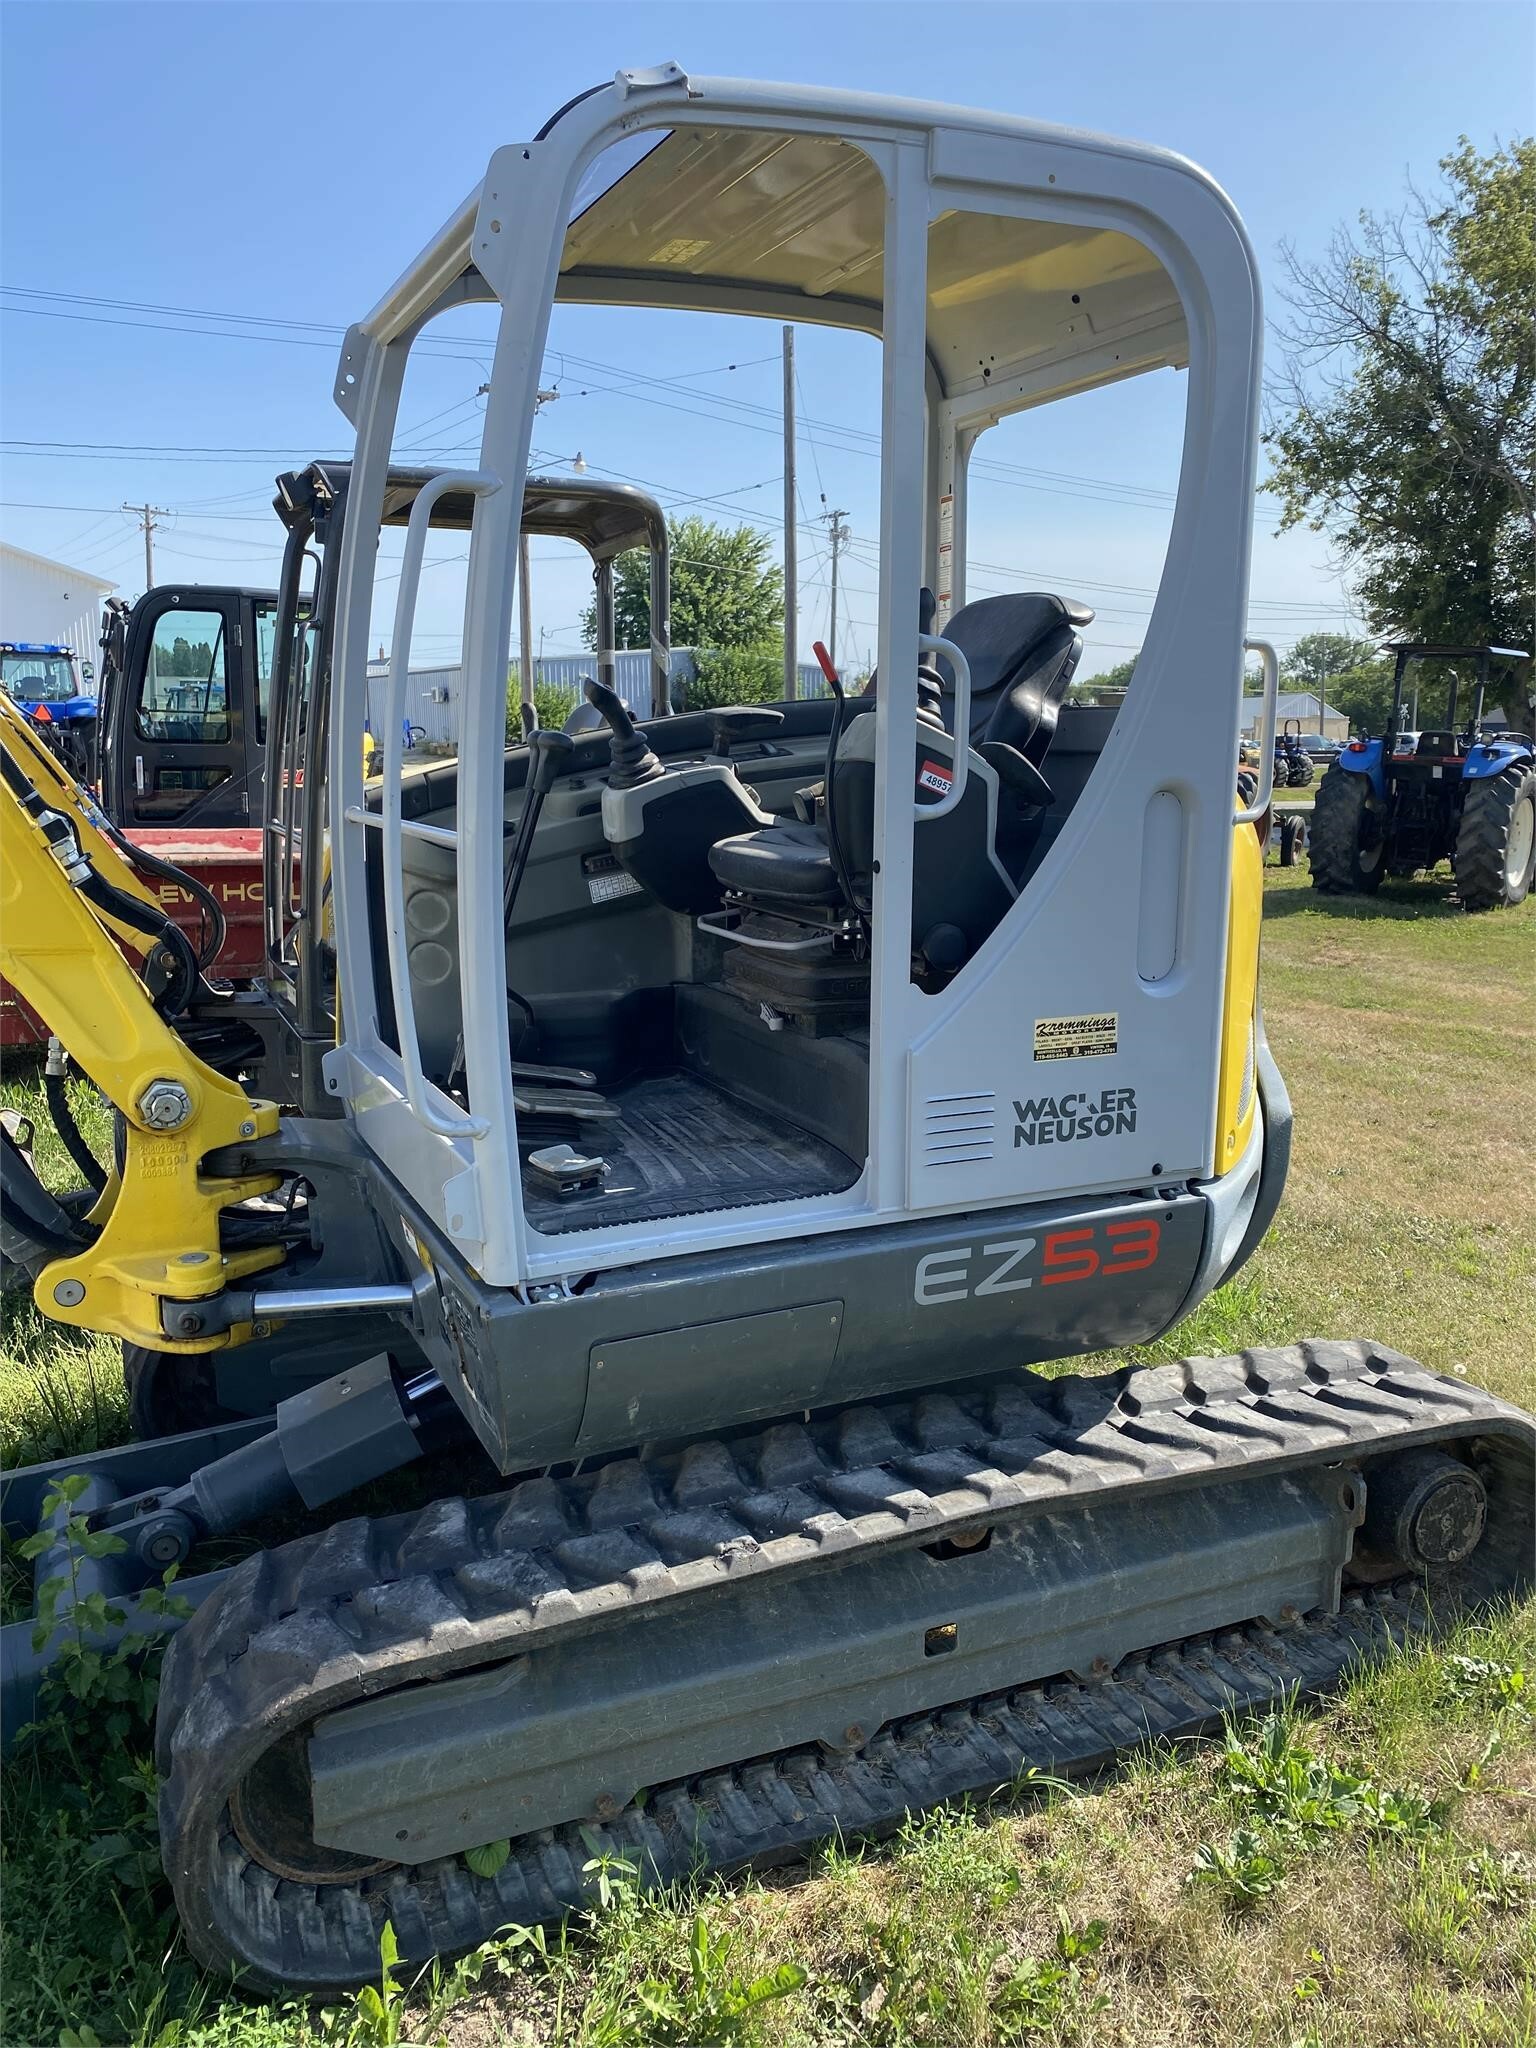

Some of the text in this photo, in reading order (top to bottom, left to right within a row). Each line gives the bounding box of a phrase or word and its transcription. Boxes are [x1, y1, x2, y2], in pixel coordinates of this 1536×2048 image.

[926, 775, 952, 792] 48957
[1036, 1017, 1117, 1037] Kromminga
[1053, 1028, 1097, 1036] MOTORS
[1013, 1110, 1137, 1148] NEUSON
[914, 1218, 1161, 1306] EZ53
